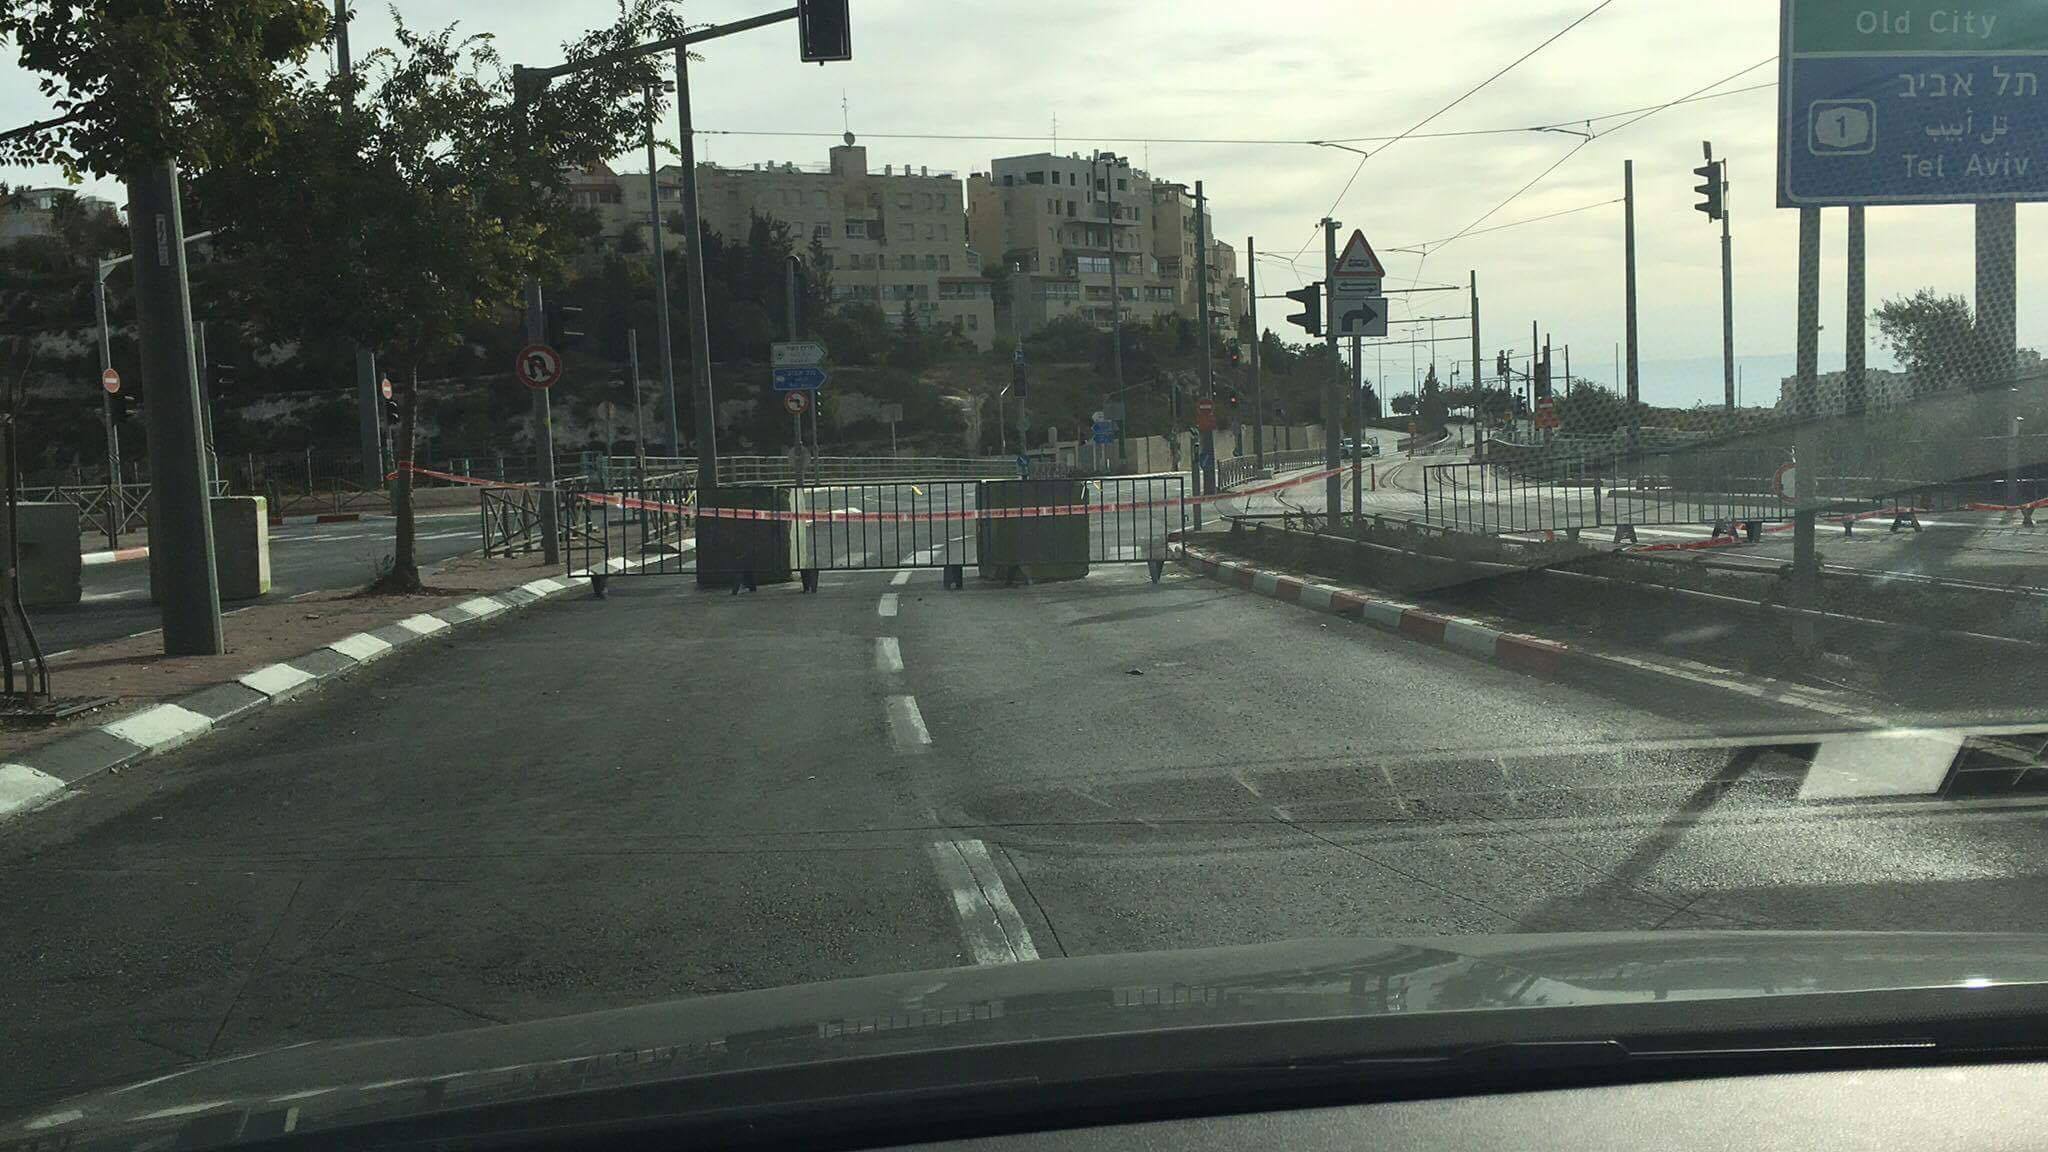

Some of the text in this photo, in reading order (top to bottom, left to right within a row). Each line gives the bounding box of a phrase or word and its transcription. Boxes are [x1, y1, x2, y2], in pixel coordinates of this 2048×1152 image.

[1856, 11, 1996, 38] Old City
[1899, 65, 2037, 97] תל אביב
[1836, 115, 1846, 139] 1
[1926, 107, 2008, 144] تل أبيب
[1902, 152, 2029, 177] Tel Aviv
